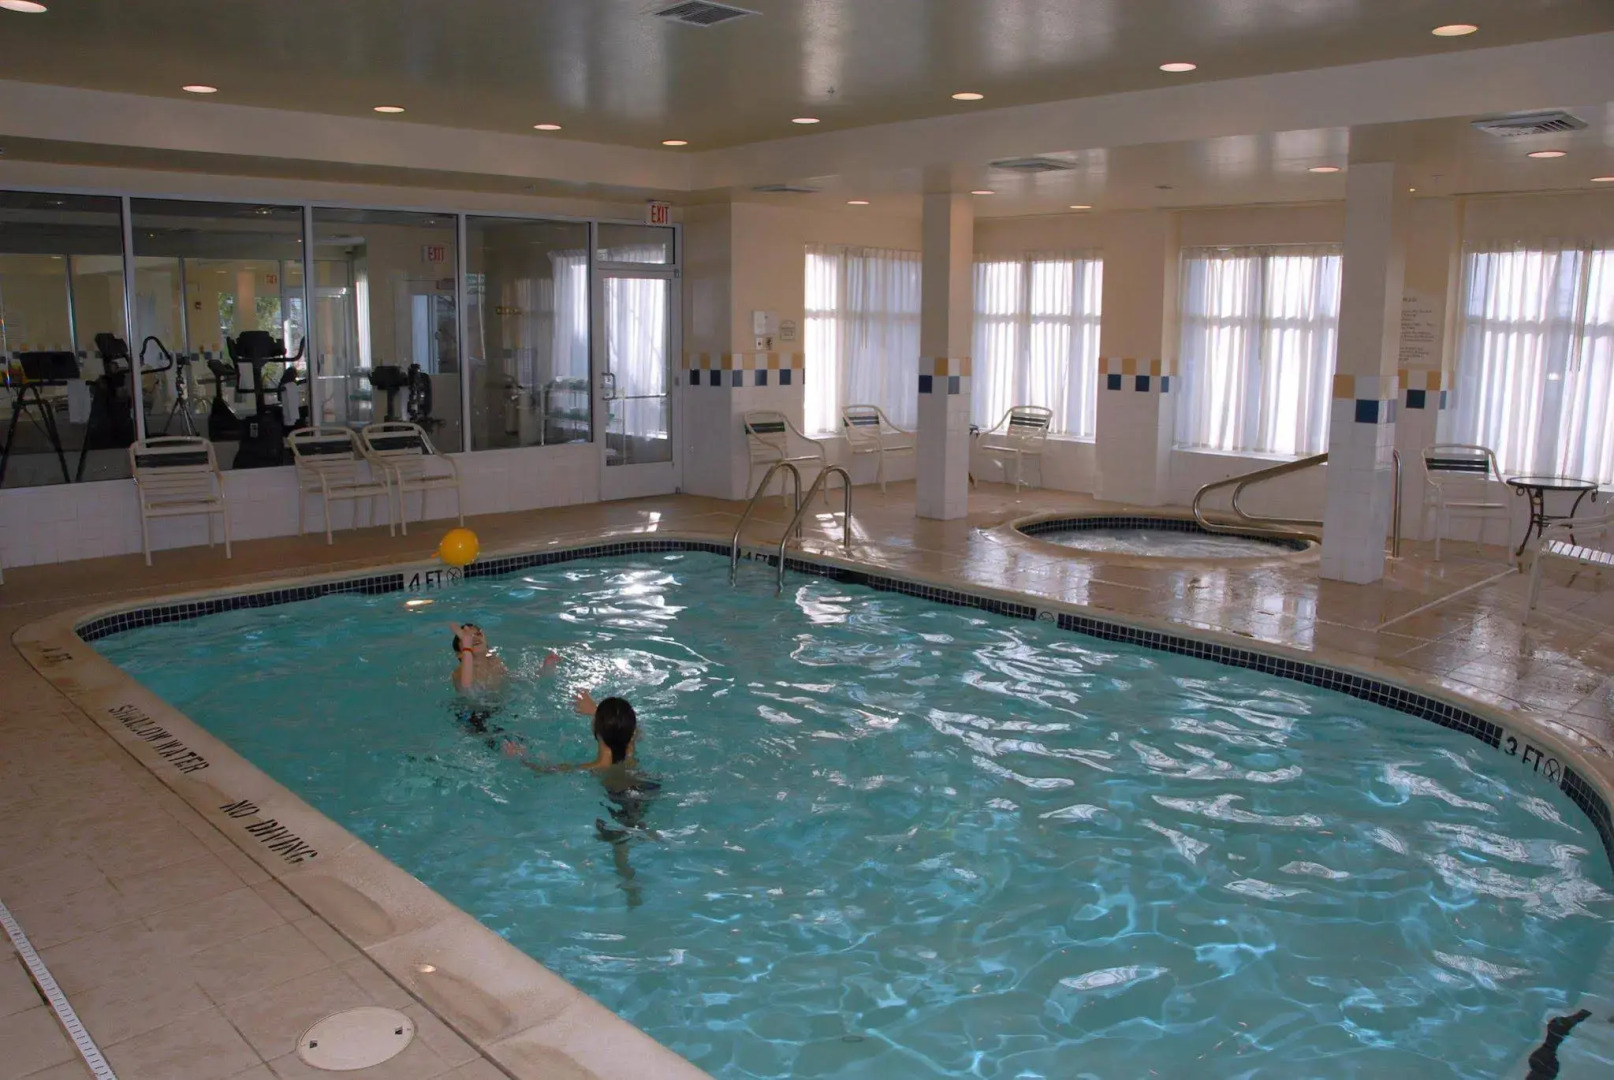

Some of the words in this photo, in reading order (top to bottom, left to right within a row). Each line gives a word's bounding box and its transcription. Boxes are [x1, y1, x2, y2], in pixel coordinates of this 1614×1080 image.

[651, 204, 670, 225] EXIT
[425, 569, 443, 585] FT
[108, 704, 173, 742] SHALLOW
[152, 739, 210, 774] WATER
[1504, 736, 1518, 756] 3
[1522, 744, 1545, 772] FT
[219, 799, 260, 818] NO
[244, 819, 318, 865] DIVING
